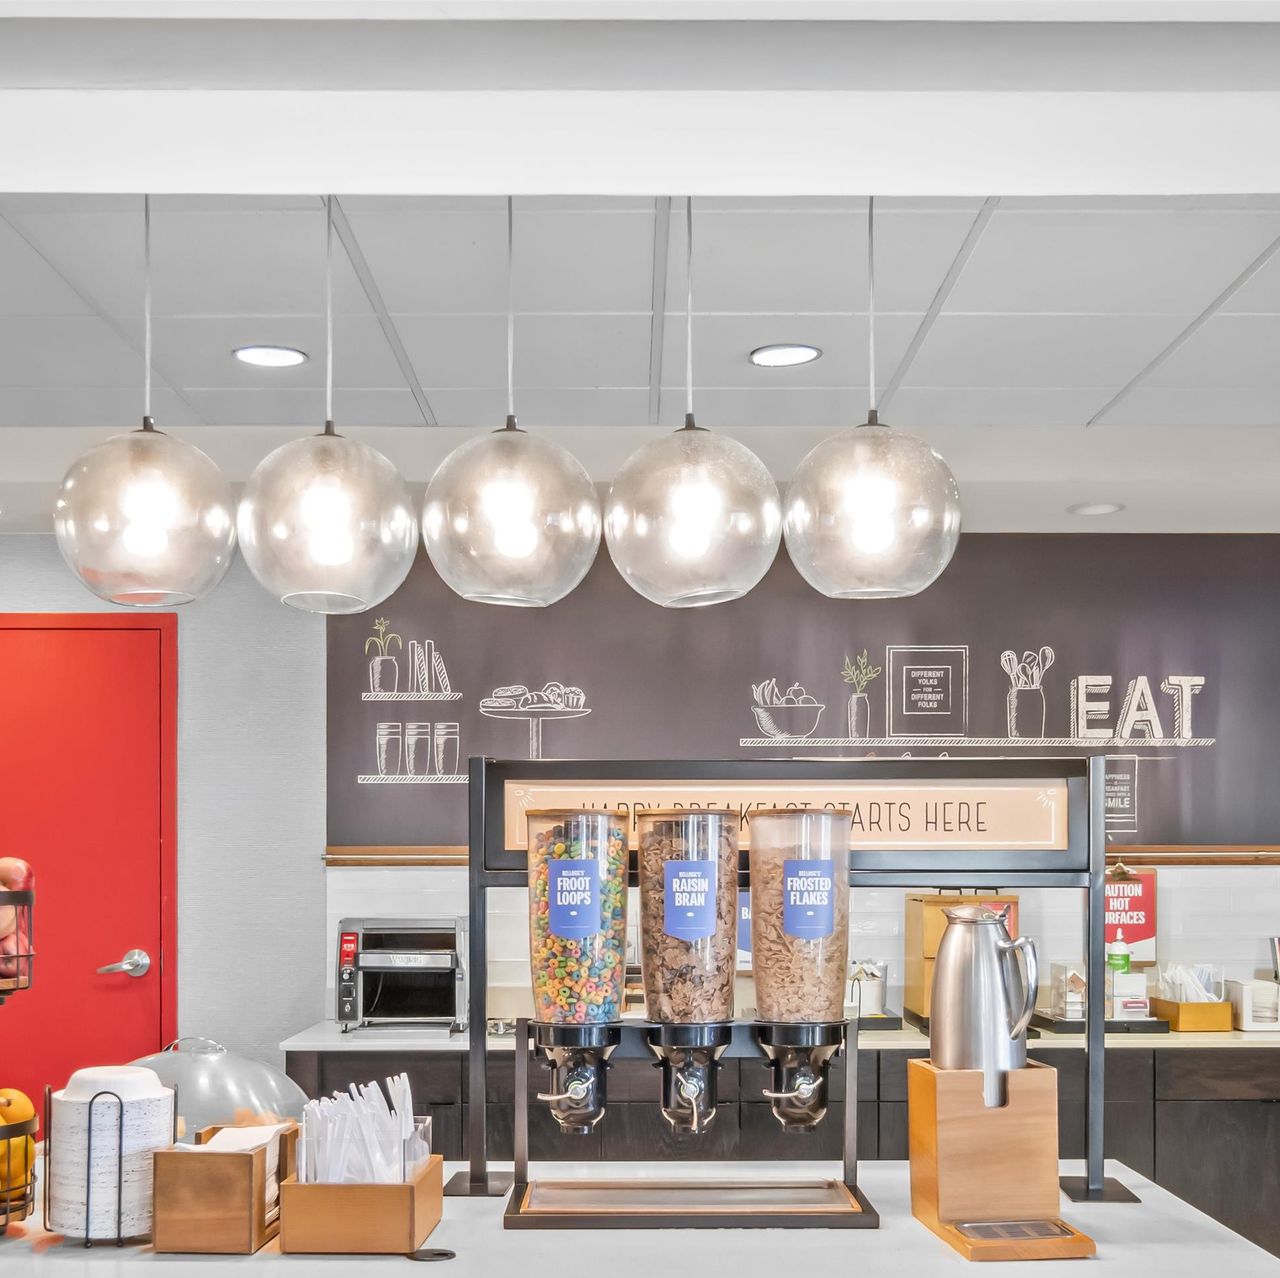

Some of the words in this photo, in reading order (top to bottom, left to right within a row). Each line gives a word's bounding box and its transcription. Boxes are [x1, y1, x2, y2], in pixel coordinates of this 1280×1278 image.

[910, 670, 945, 678] DIFFERENT
[917, 678, 938, 686] YOLKS
[910, 693, 945, 701] DIFFERENT
[1071, 675, 1205, 739] EAT
[824, 802, 911, 832] ARTS
[925, 802, 987, 832] HERE
[557, 877, 591, 891] FROOT
[672, 878, 709, 892] RAISIN
[787, 877, 832, 891] FROSTED
[1104, 883, 1142, 897] AUTION
[557, 891, 591, 905] LOOPS
[674, 892, 706, 906] BRAN
[790, 891, 829, 905] FLAKES
[1109, 898, 1131, 911] HOT
